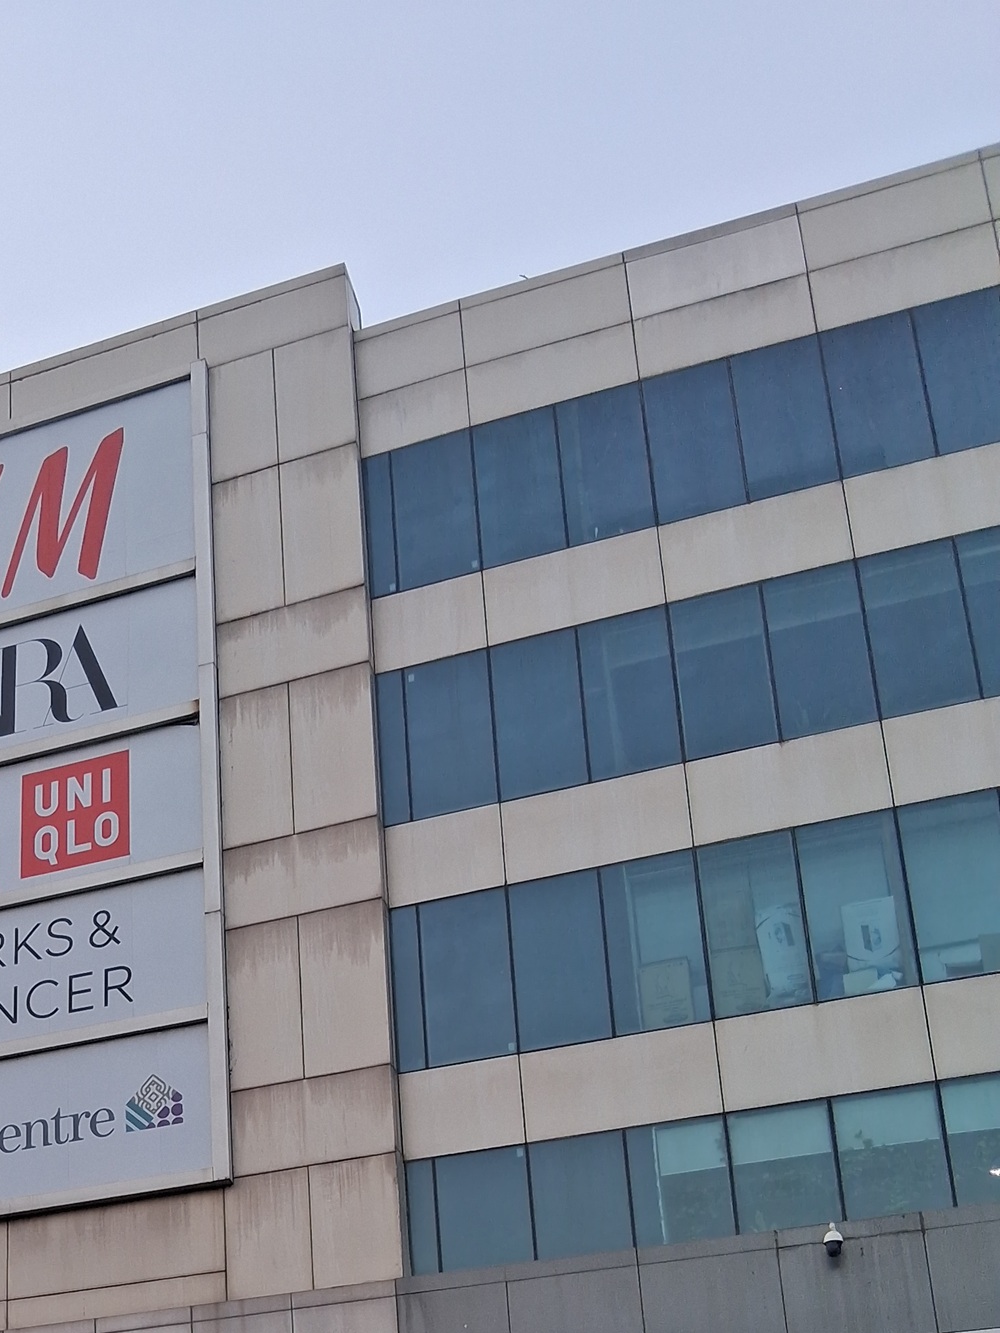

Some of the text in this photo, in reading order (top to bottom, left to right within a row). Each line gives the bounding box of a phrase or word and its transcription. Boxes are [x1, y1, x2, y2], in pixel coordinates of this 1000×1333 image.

[34, 768, 111, 817] UNI
[33, 811, 119, 865] QLO
[89, 909, 121, 948] &
